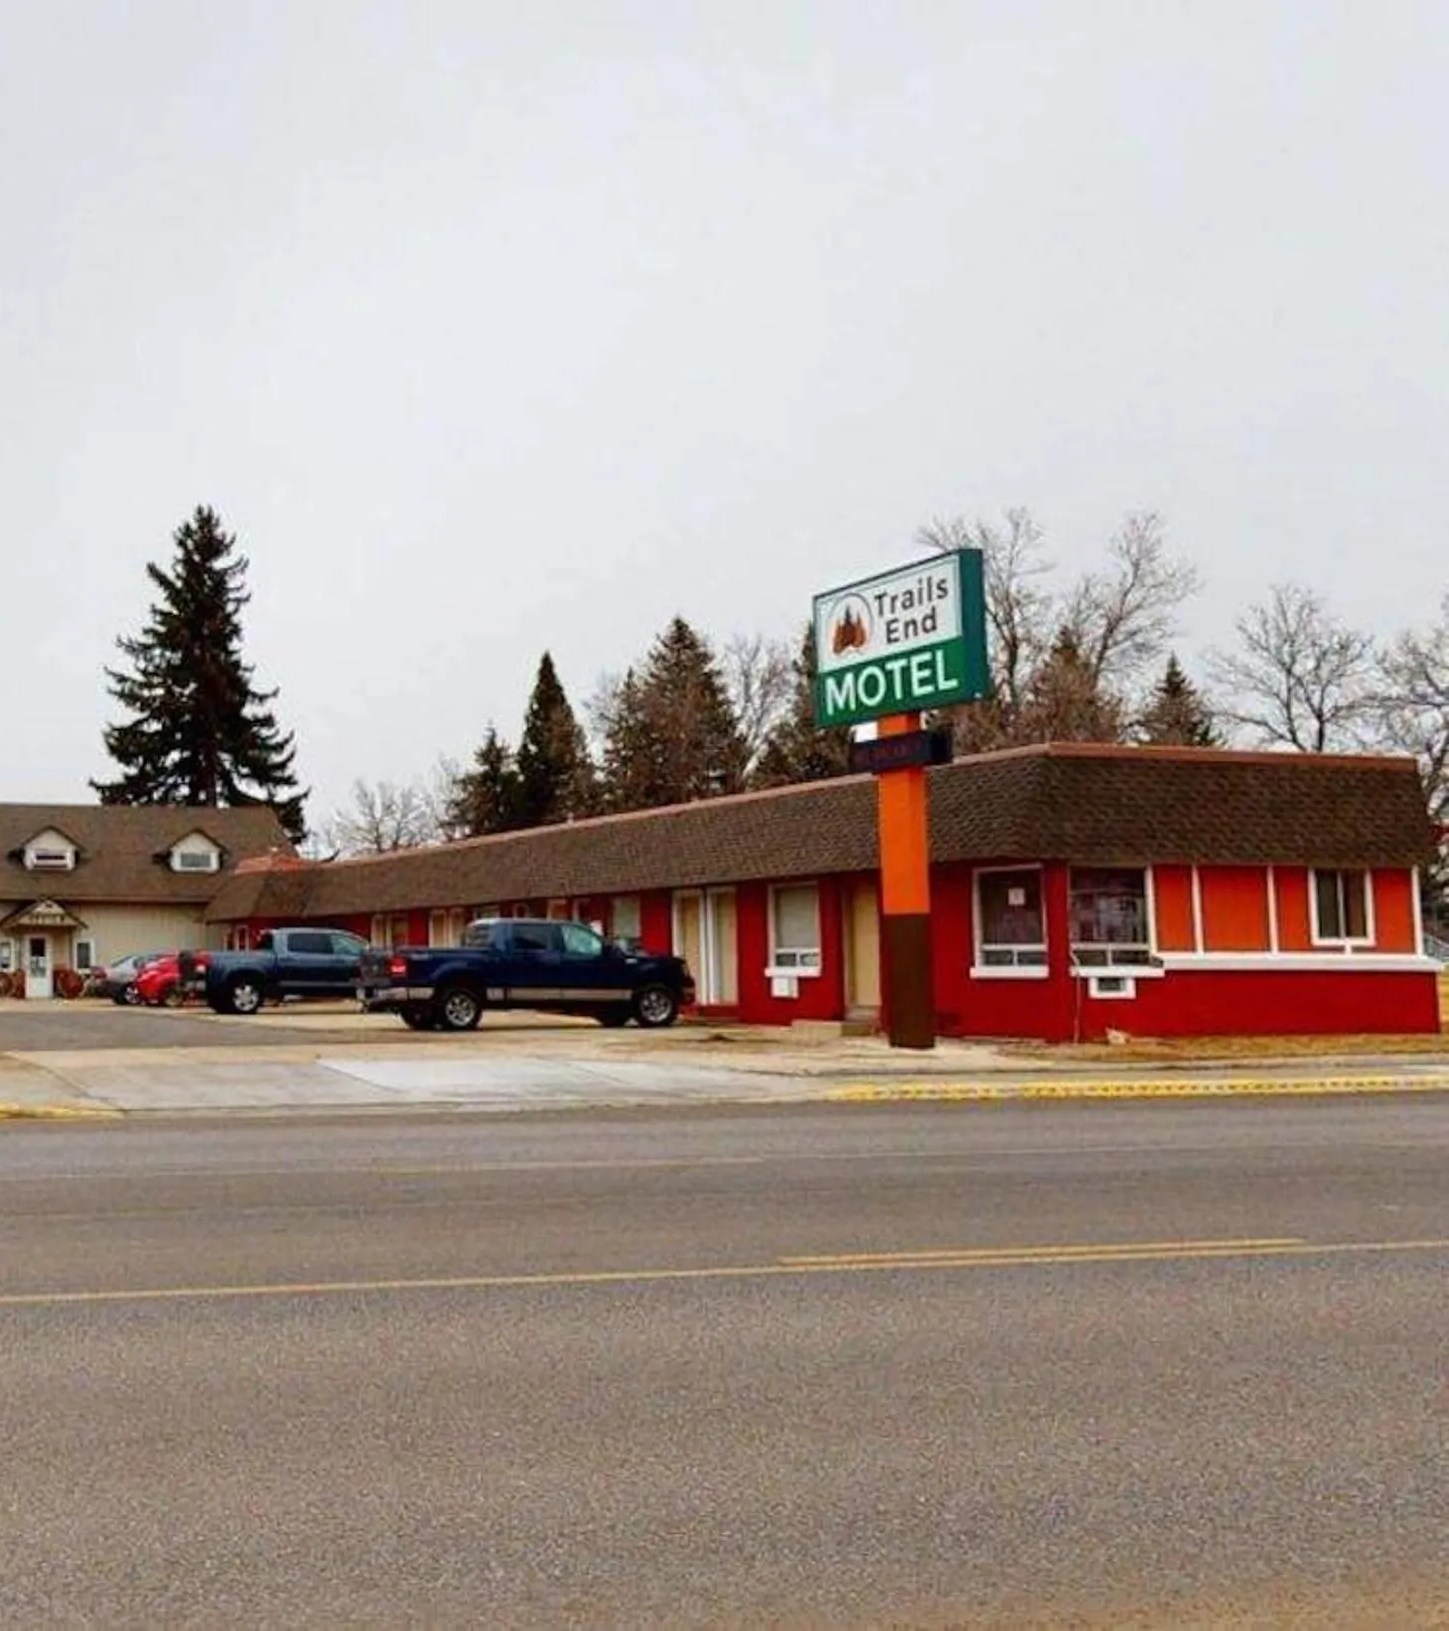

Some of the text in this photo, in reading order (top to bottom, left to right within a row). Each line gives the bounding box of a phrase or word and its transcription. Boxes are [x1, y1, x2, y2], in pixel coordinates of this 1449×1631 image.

[874, 576, 948, 618] Trails
[886, 607, 937, 644] End
[824, 649, 959, 716] MOTEL
